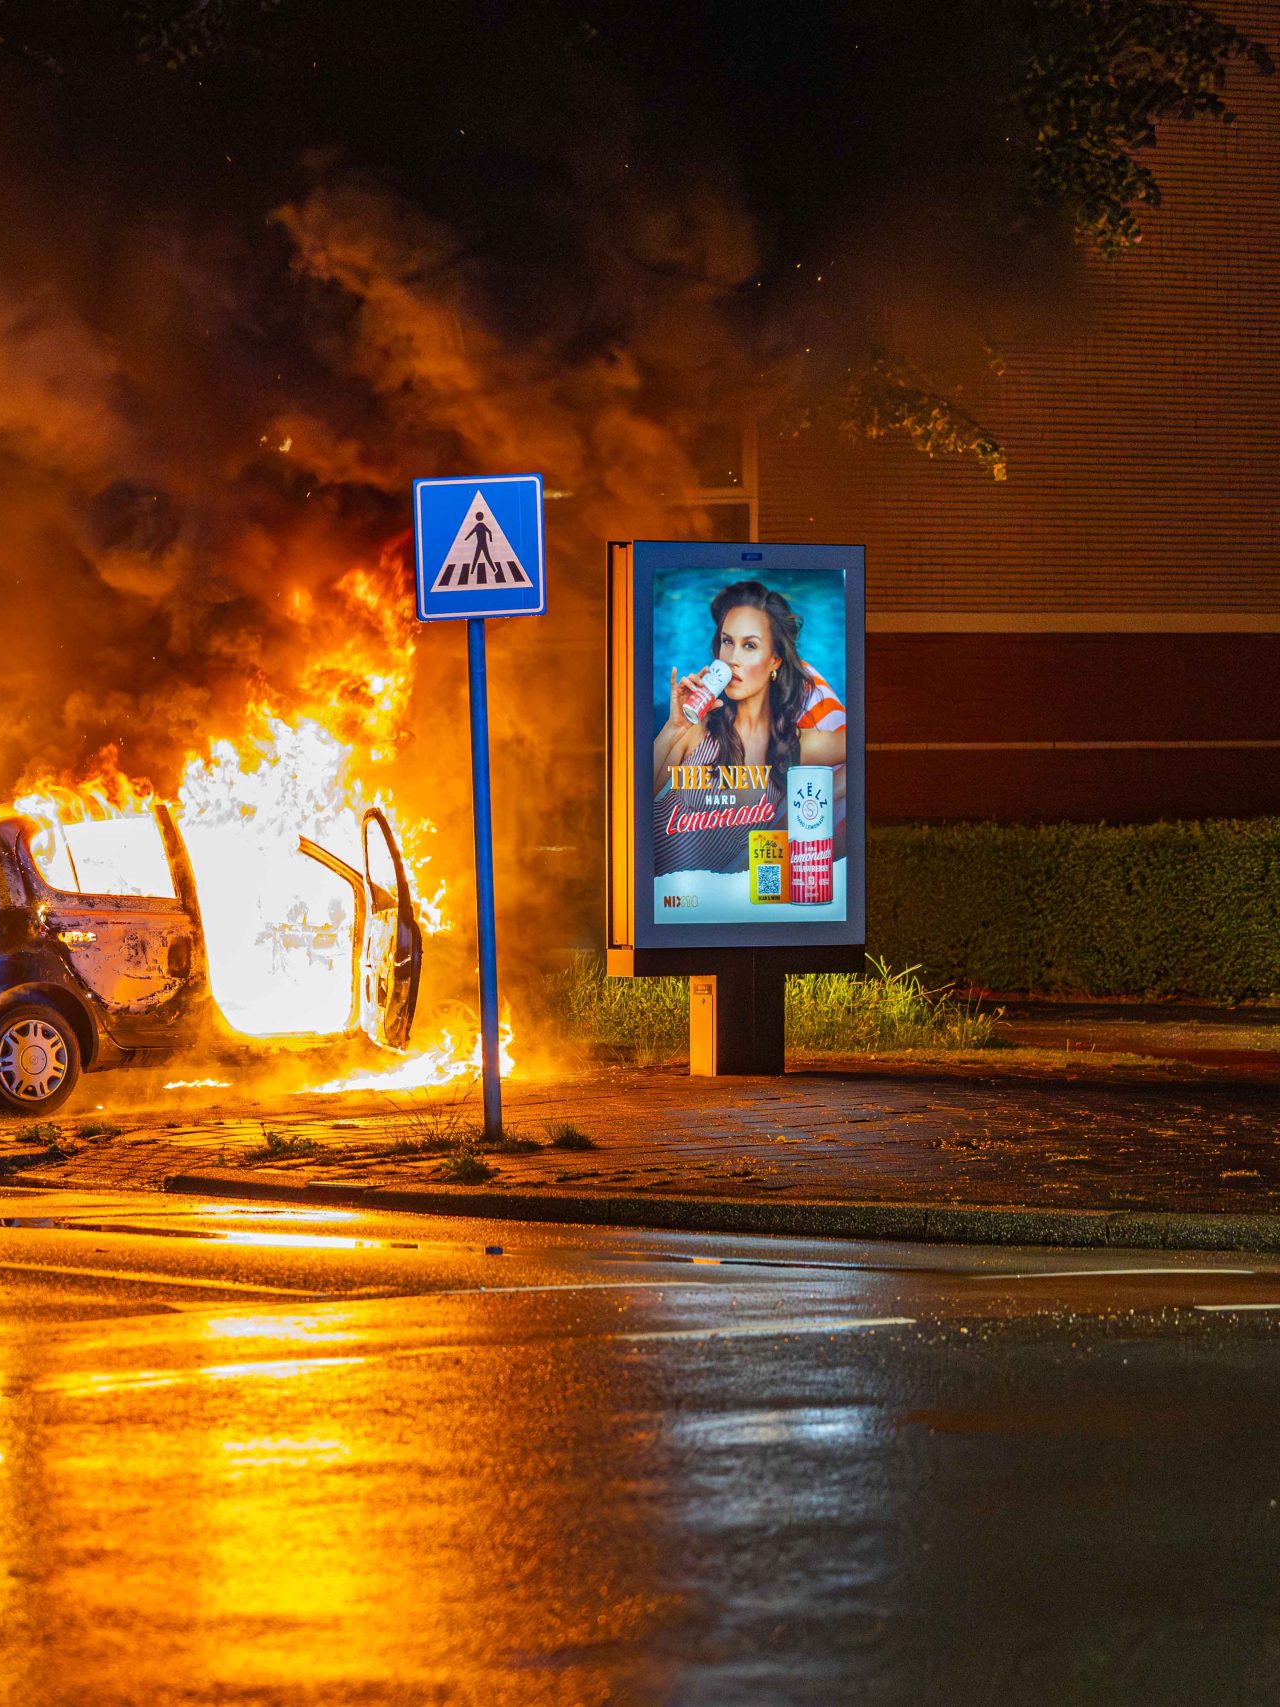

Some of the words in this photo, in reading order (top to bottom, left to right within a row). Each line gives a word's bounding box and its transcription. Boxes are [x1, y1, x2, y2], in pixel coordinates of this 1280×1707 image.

[667, 765, 713, 790] THE
[718, 765, 773, 790] NEW
[705, 795, 737, 805] HARD
[793, 782, 828, 809] STËLZ
[665, 793, 776, 835] Lemonade
[754, 847, 784, 859] STËLZ
